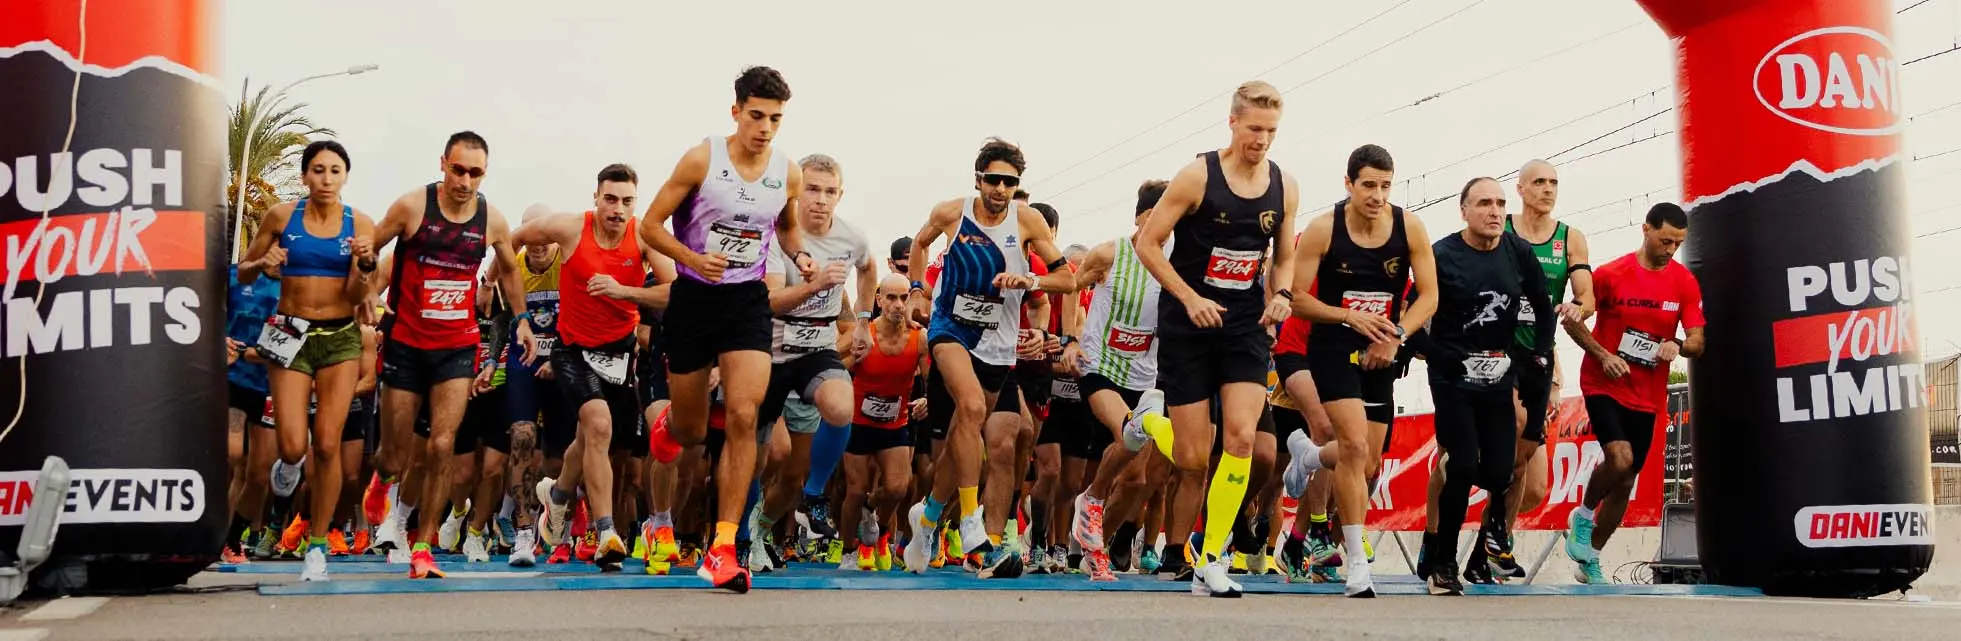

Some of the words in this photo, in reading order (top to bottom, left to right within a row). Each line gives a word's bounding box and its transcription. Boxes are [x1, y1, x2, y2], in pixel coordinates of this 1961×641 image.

[1776, 52, 1899, 114] DANI
[720, 237, 751, 252] 972
[3, 206, 157, 304] YOUR
[1213, 260, 1255, 276] 2964
[429, 290, 466, 305] 2476
[963, 302, 993, 316] 548
[0, 286, 201, 357] MITS
[795, 329, 821, 341] 521
[1631, 339, 1654, 352] 1151
[1472, 360, 1500, 372] 767
[870, 402, 891, 414] 724
[1809, 511, 1931, 540] DANIEVEN
